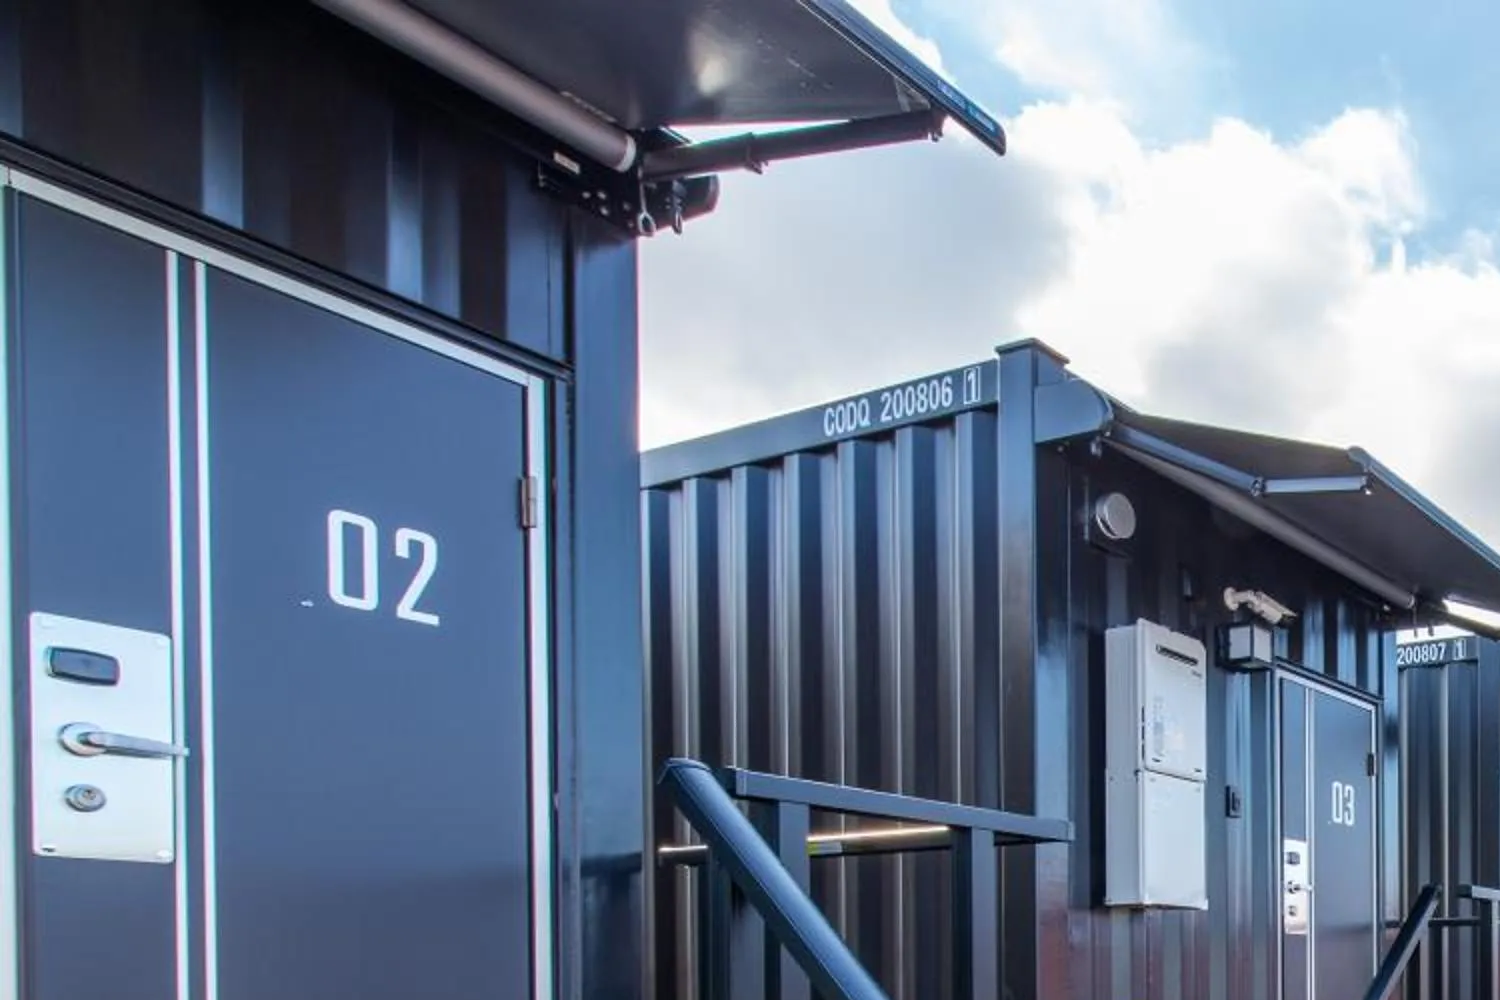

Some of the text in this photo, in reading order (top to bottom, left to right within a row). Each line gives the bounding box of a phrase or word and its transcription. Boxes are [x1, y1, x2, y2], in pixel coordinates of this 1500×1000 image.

[880, 376, 953, 423] 200806
[965, 367, 978, 403] 1
[327, 509, 440, 627] 02
[1396, 639, 1464, 665] 200807 1
[1332, 780, 1355, 827] 03
